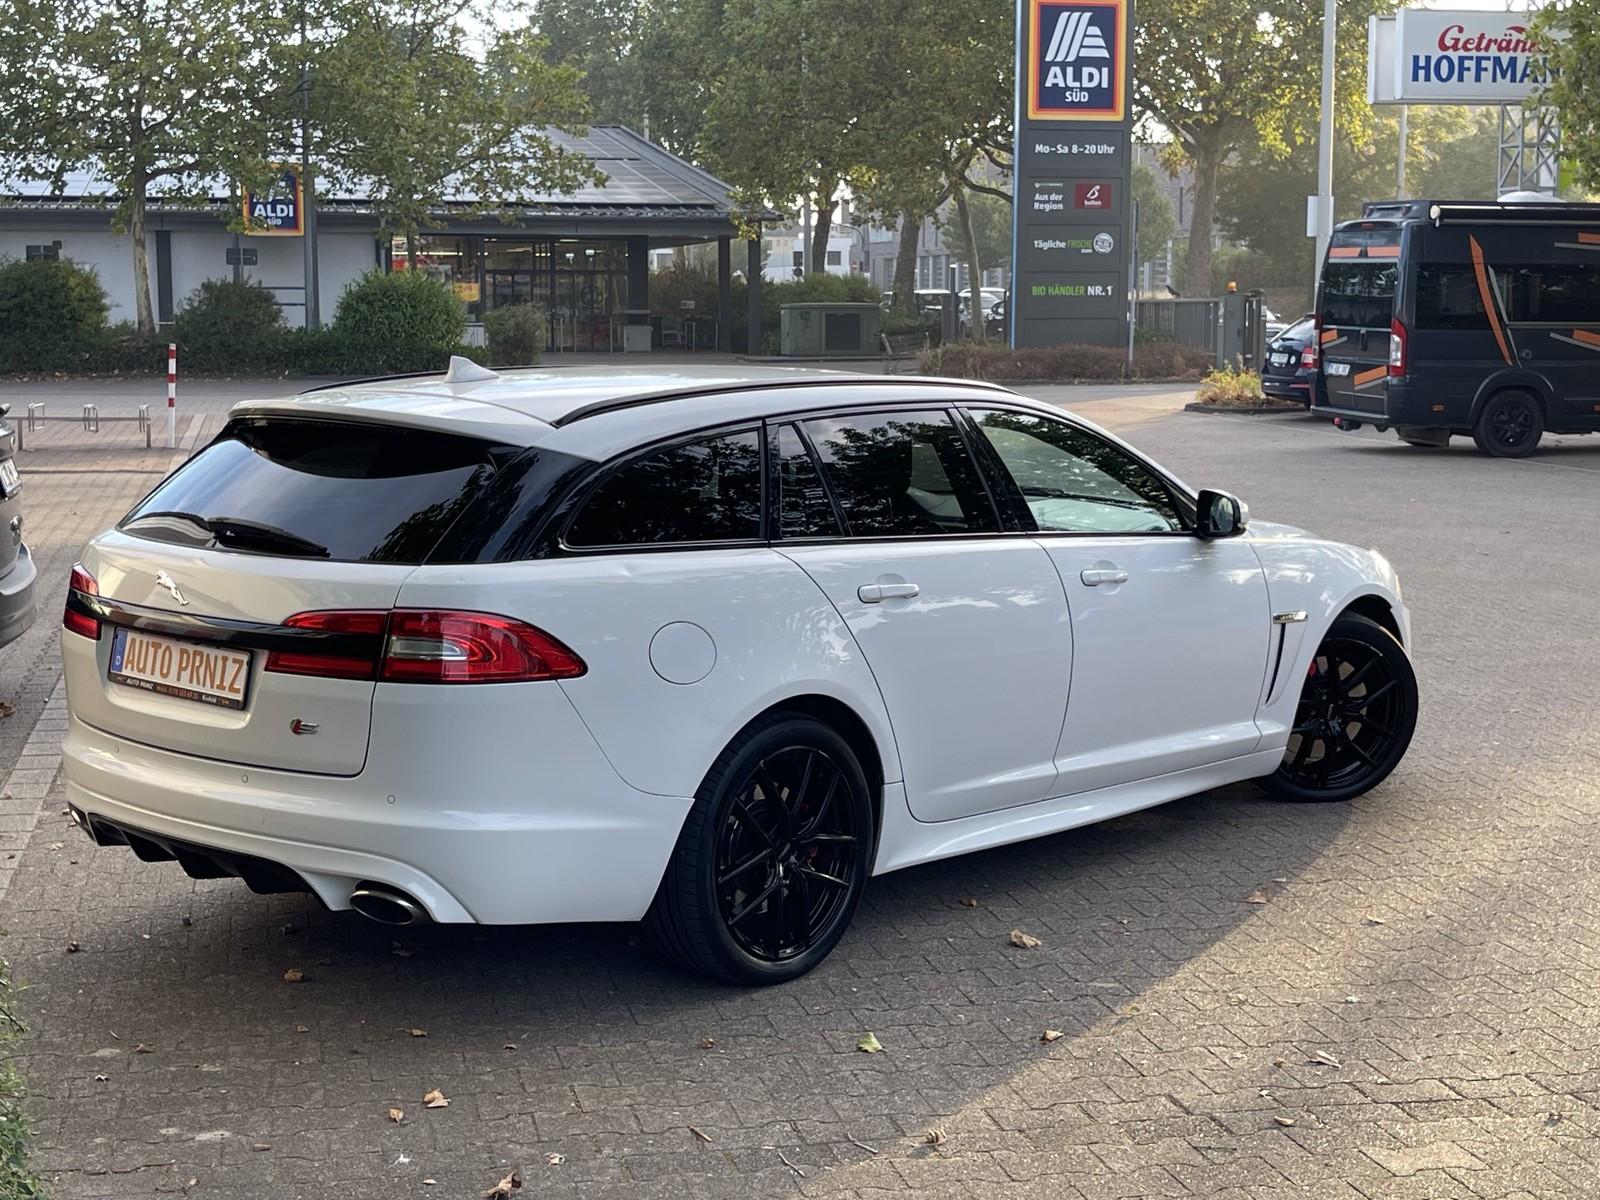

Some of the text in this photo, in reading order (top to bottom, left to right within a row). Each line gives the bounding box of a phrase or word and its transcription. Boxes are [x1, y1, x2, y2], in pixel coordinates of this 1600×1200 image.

[1044, 66, 1109, 88] ALDI
[1065, 88, 1089, 102] SÜD
[1097, 144, 1115, 154] Uhr
[1034, 193, 1063, 201] Aus der
[254, 204, 294, 217] ALDI
[1033, 202, 1063, 212] Region
[267, 217, 282, 225] SÜD
[1033, 239, 1066, 250] Tägliche
[1031, 284, 1113, 296] BIO HÄNDLER NR. 1
[124, 637, 245, 694] AUTO PRNIZ
